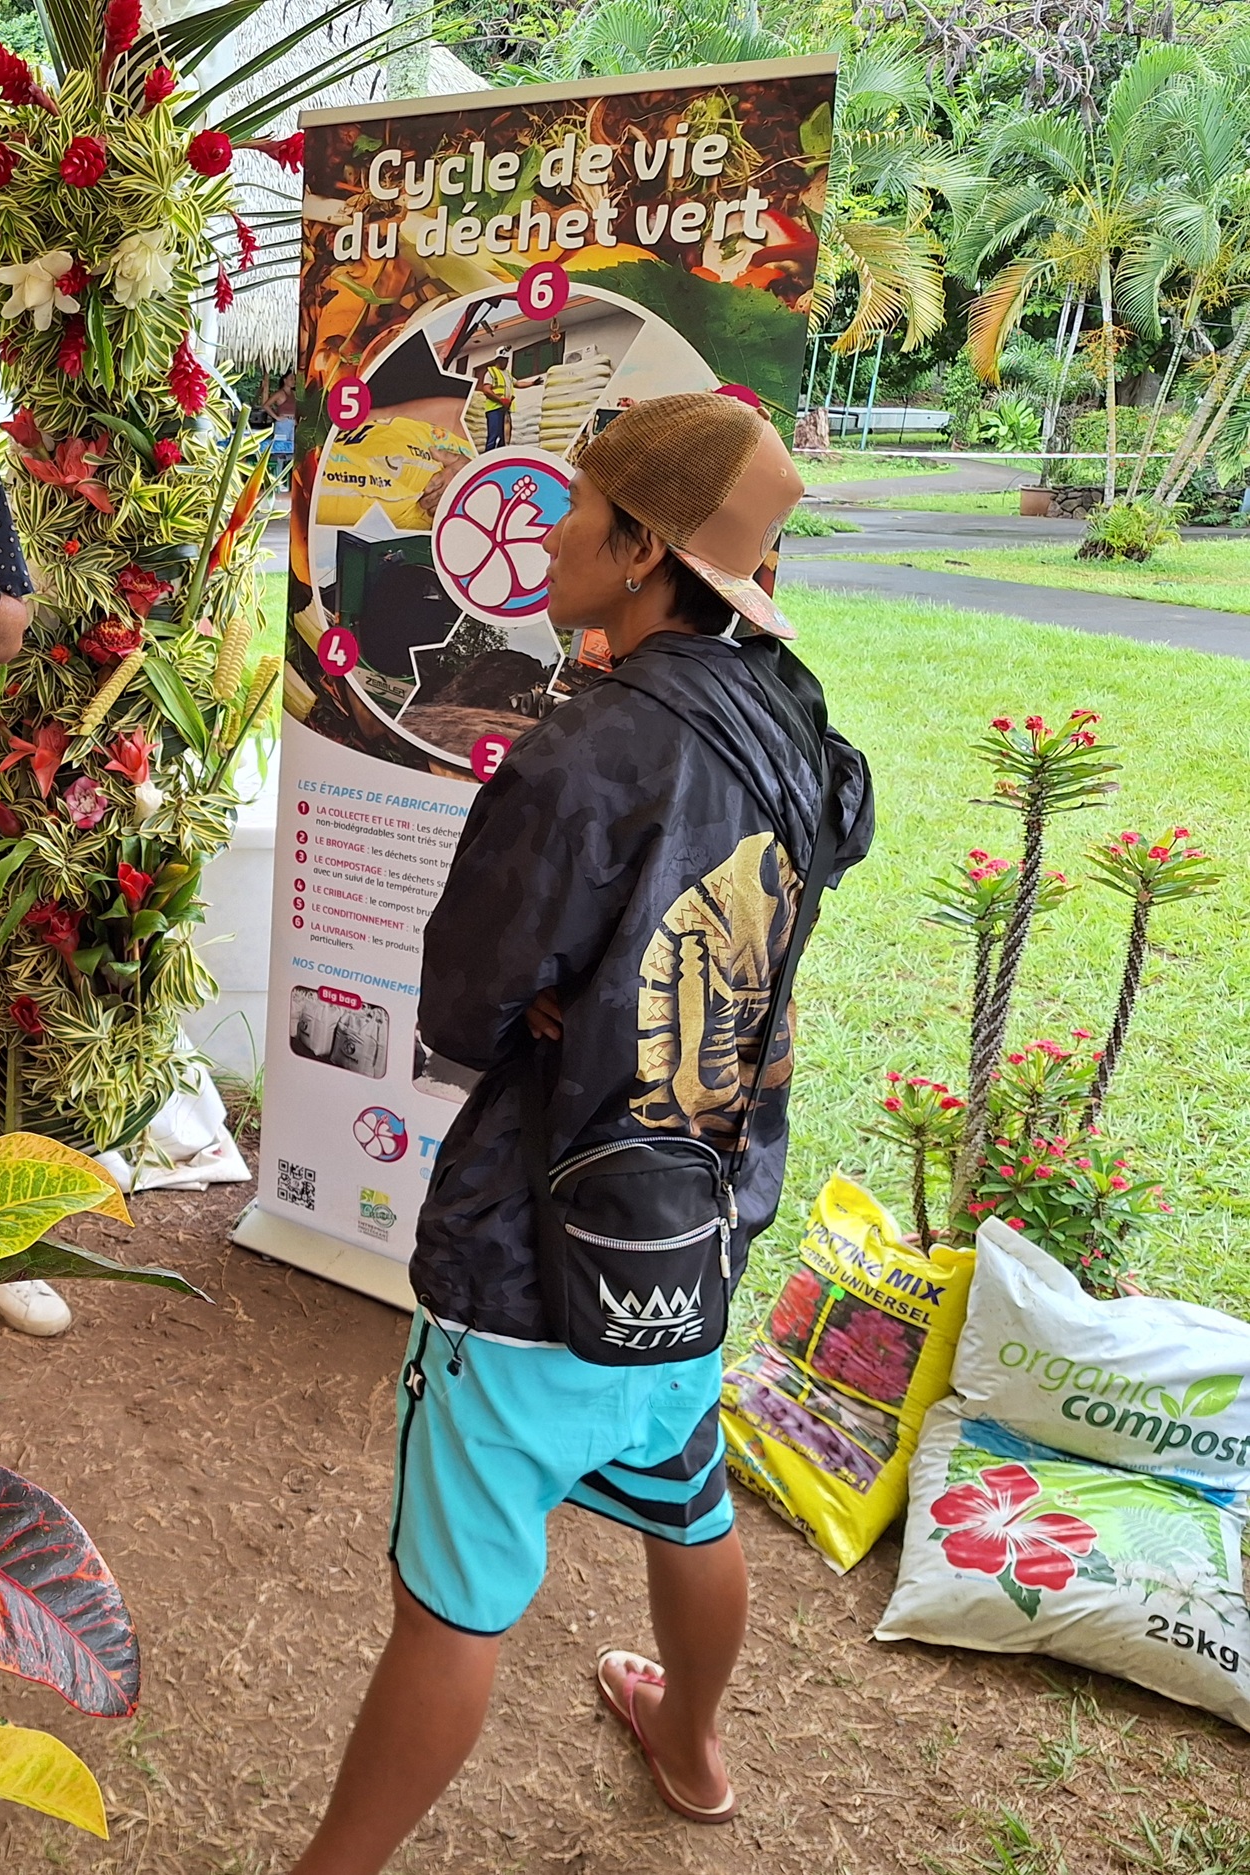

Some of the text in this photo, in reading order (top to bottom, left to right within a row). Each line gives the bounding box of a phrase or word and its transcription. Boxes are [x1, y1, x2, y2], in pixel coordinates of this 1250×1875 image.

[368, 123, 729, 211] Cycle de vie
[333, 187, 770, 262] du déchet vert
[530, 271, 554, 309] 6
[340, 386, 361, 420] 5
[326, 635, 346, 667] 4
[297, 779, 469, 818] LES ÉTAPES DE FABRICATION
[315, 818, 395, 839] non-biodégradables
[396, 833, 416, 843] sont
[417, 836, 437, 847] triés
[438, 841, 453, 849] sur
[316, 805, 327, 815] LA
[328, 808, 370, 823] COLLECTE
[371, 815, 382, 825] ET
[384, 817, 395, 827] LE
[396, 819, 410, 830] TRI
[416, 823, 431, 834] Les
[314, 836, 324, 845] LE
[325, 838, 366, 853] BROYAGE
[371, 846, 383, 857] les
[384, 849, 417, 863] déchets
[419, 857, 439, 867] sont
[313, 855, 324, 864] LE
[324, 857, 383, 876] COMPOSTAGE
[388, 869, 401, 879] les
[401, 872, 435, 887] déchets
[313, 867, 439, 899] avec un suivi de la température
[312, 884, 322, 894] LE
[323, 887, 364, 903] CRIBLAGE
[369, 896, 377, 906] le
[378, 900, 414, 912] compost
[311, 903, 321, 912] LE
[322, 906, 405, 930] CONDITIONNEMENT
[412, 925, 421, 934] le
[310, 922, 321, 931] LA
[322, 924, 366, 941] LIVRAISON
[372, 935, 384, 946] les
[385, 940, 420, 954] produits
[310, 934, 355, 950] particuliers.
[291, 956, 315, 971] NOS
[322, 988, 358, 1008] Big bag
[802, 1220, 947, 1308] POTTING MIX
[840, 1272, 934, 1327] UNIVERSEL
[600, 1317, 706, 1350] ELITE
[998, 1341, 1167, 1412] organic
[1173, 1464, 1206, 1477] Semis
[1144, 1614, 1241, 1673] 25kg
